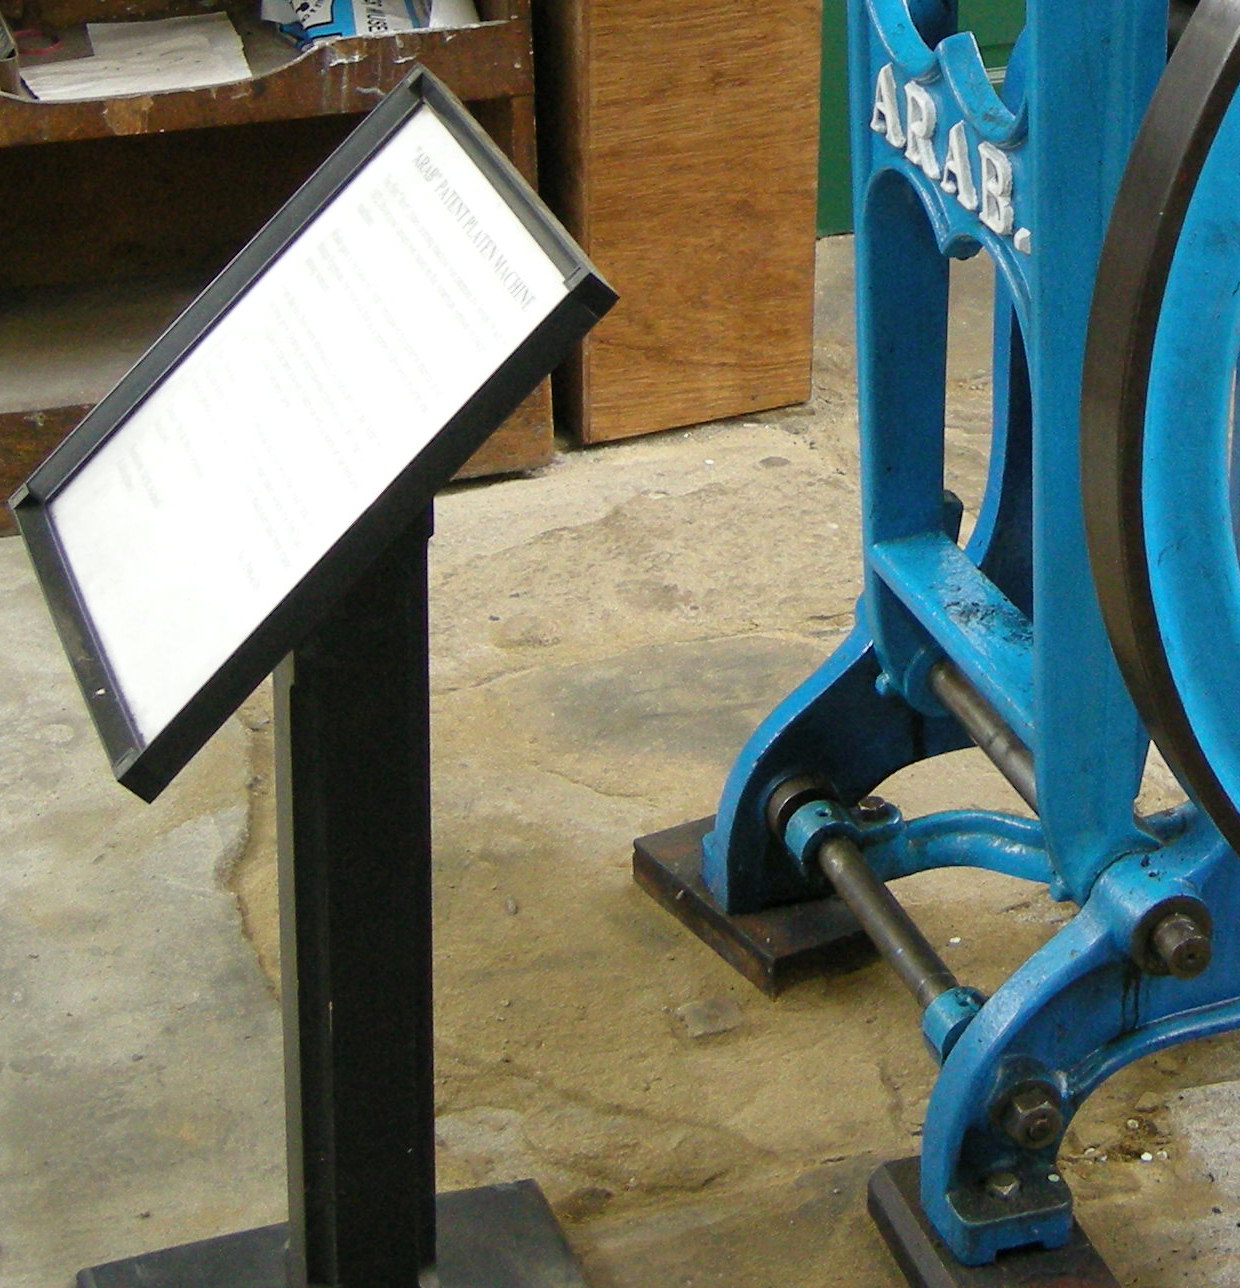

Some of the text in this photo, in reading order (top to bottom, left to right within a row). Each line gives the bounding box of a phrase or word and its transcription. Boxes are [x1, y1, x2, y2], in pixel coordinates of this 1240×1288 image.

[434, 179, 471, 223] PATENT
[462, 215, 499, 262] PLATEN
[494, 253, 538, 313] MACHINE
